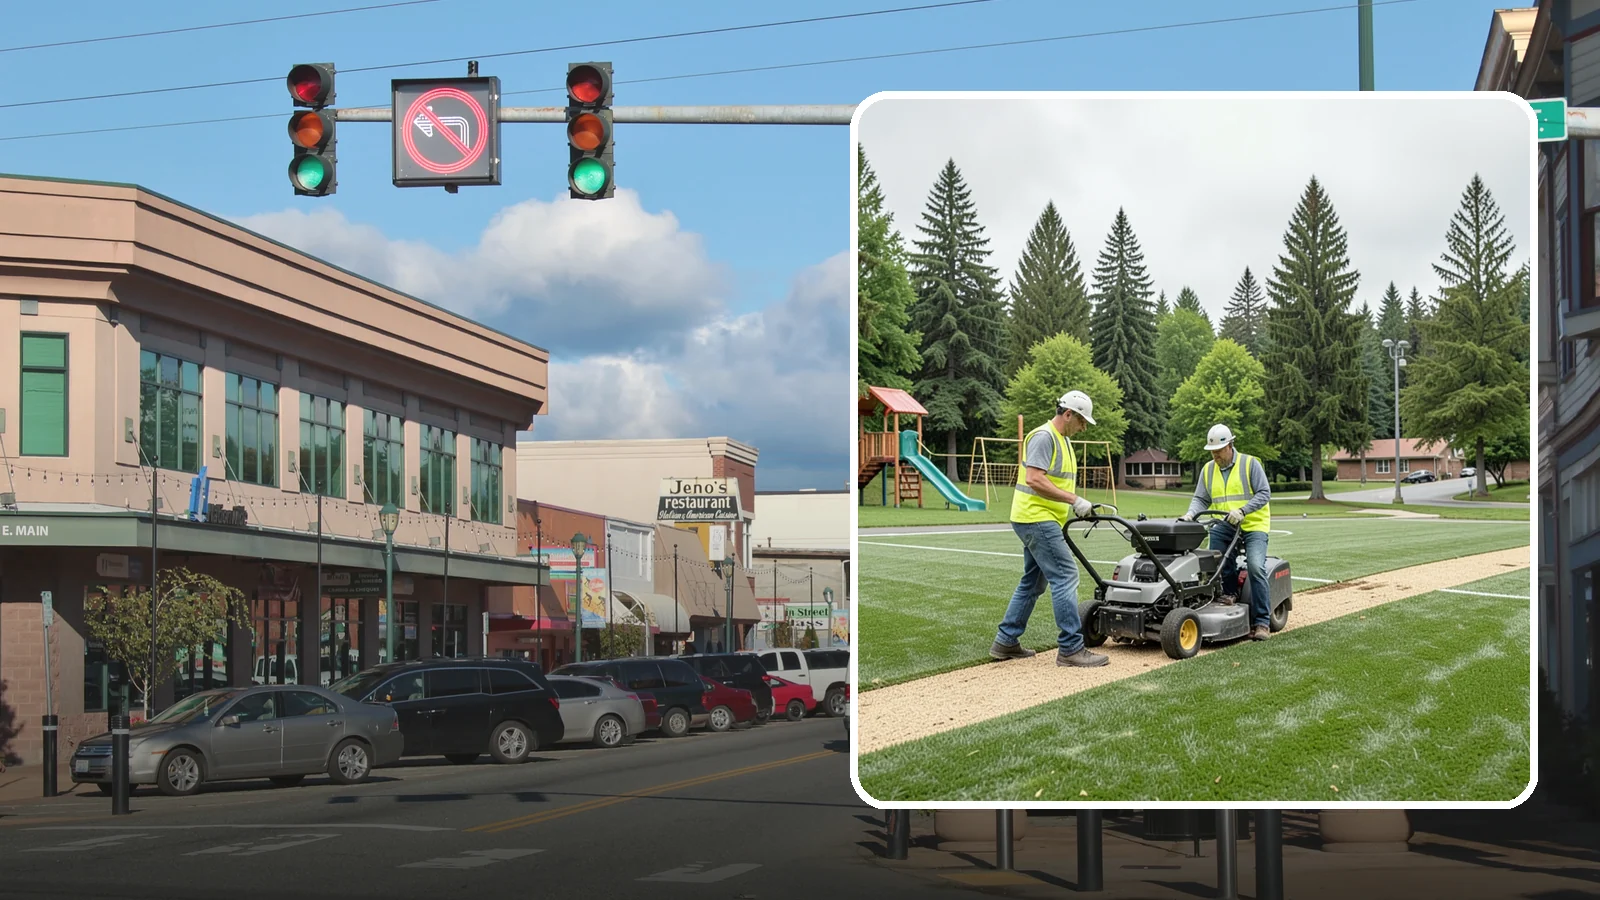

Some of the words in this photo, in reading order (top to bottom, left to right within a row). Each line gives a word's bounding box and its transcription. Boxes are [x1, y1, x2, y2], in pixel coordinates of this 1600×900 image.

[669, 480, 727, 494] Jeno's
[665, 496, 731, 509] restaurant
[686, 510, 714, 519] American
[715, 509, 737, 519] Cuisine
[2, 525, 13, 536] E.
[15, 525, 49, 536] MAIN
[786, 607, 795, 617] in
[797, 607, 828, 617] Street
